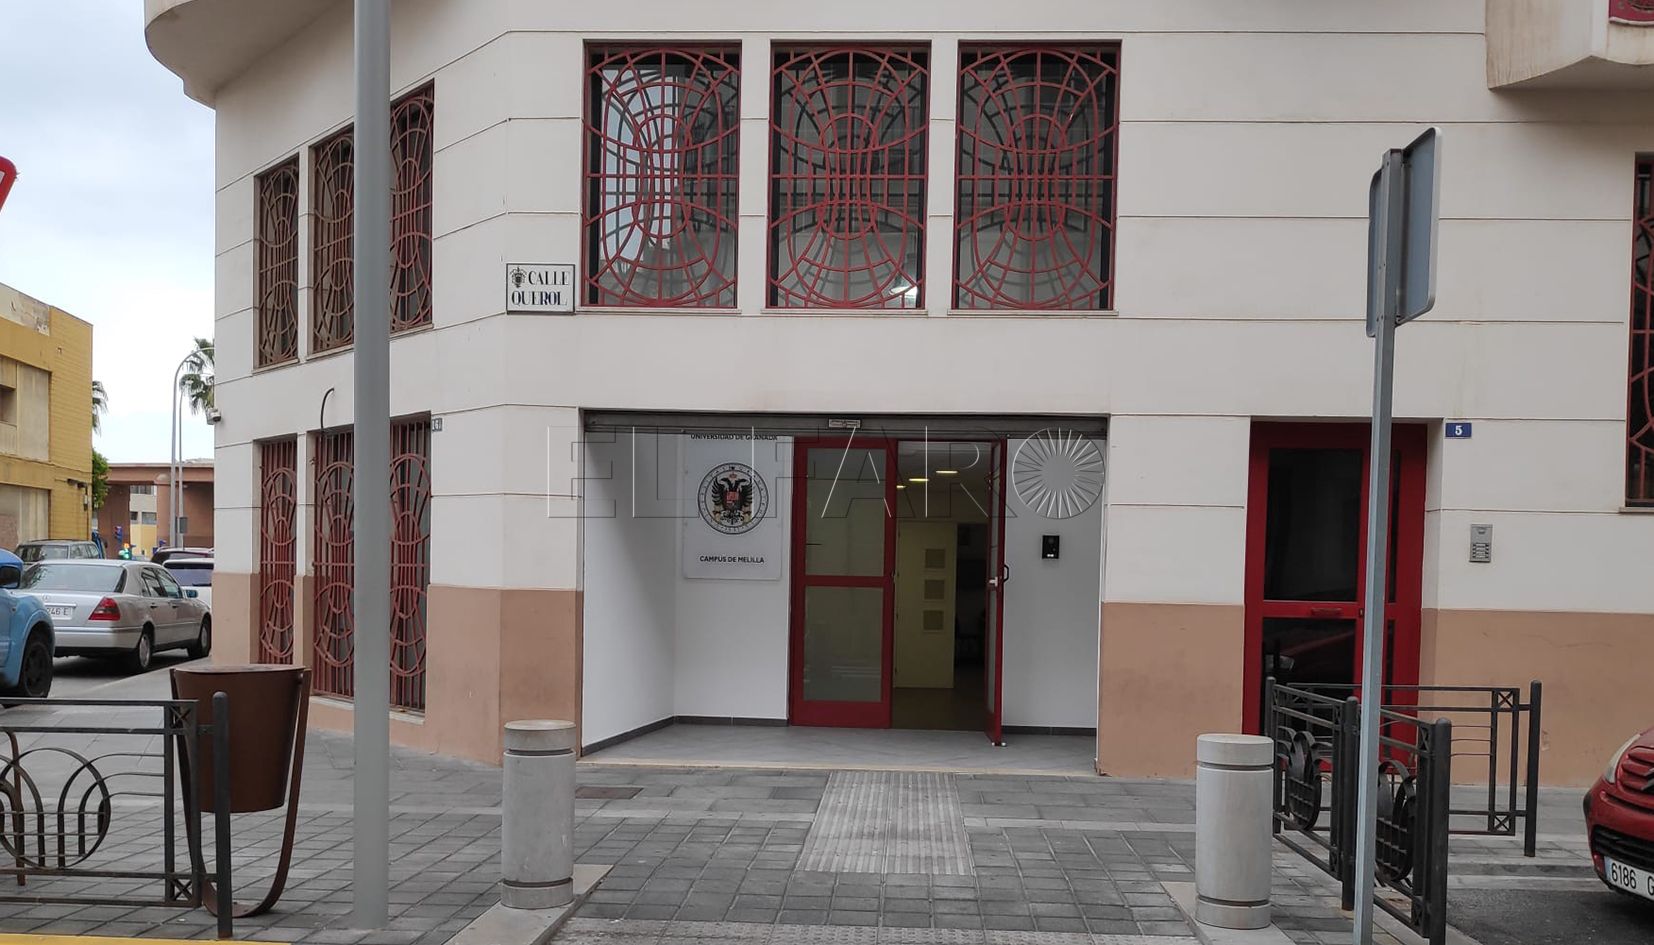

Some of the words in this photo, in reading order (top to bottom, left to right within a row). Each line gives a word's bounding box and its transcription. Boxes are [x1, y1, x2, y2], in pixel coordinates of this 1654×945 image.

[528, 270, 570, 285] CALLE
[511, 290, 568, 306] QUEROL
[1455, 425, 1463, 436] 5
[699, 555, 727, 563] CAMPUS
[737, 556, 765, 564] MELILLA
[1611, 862, 1637, 889] 6186
